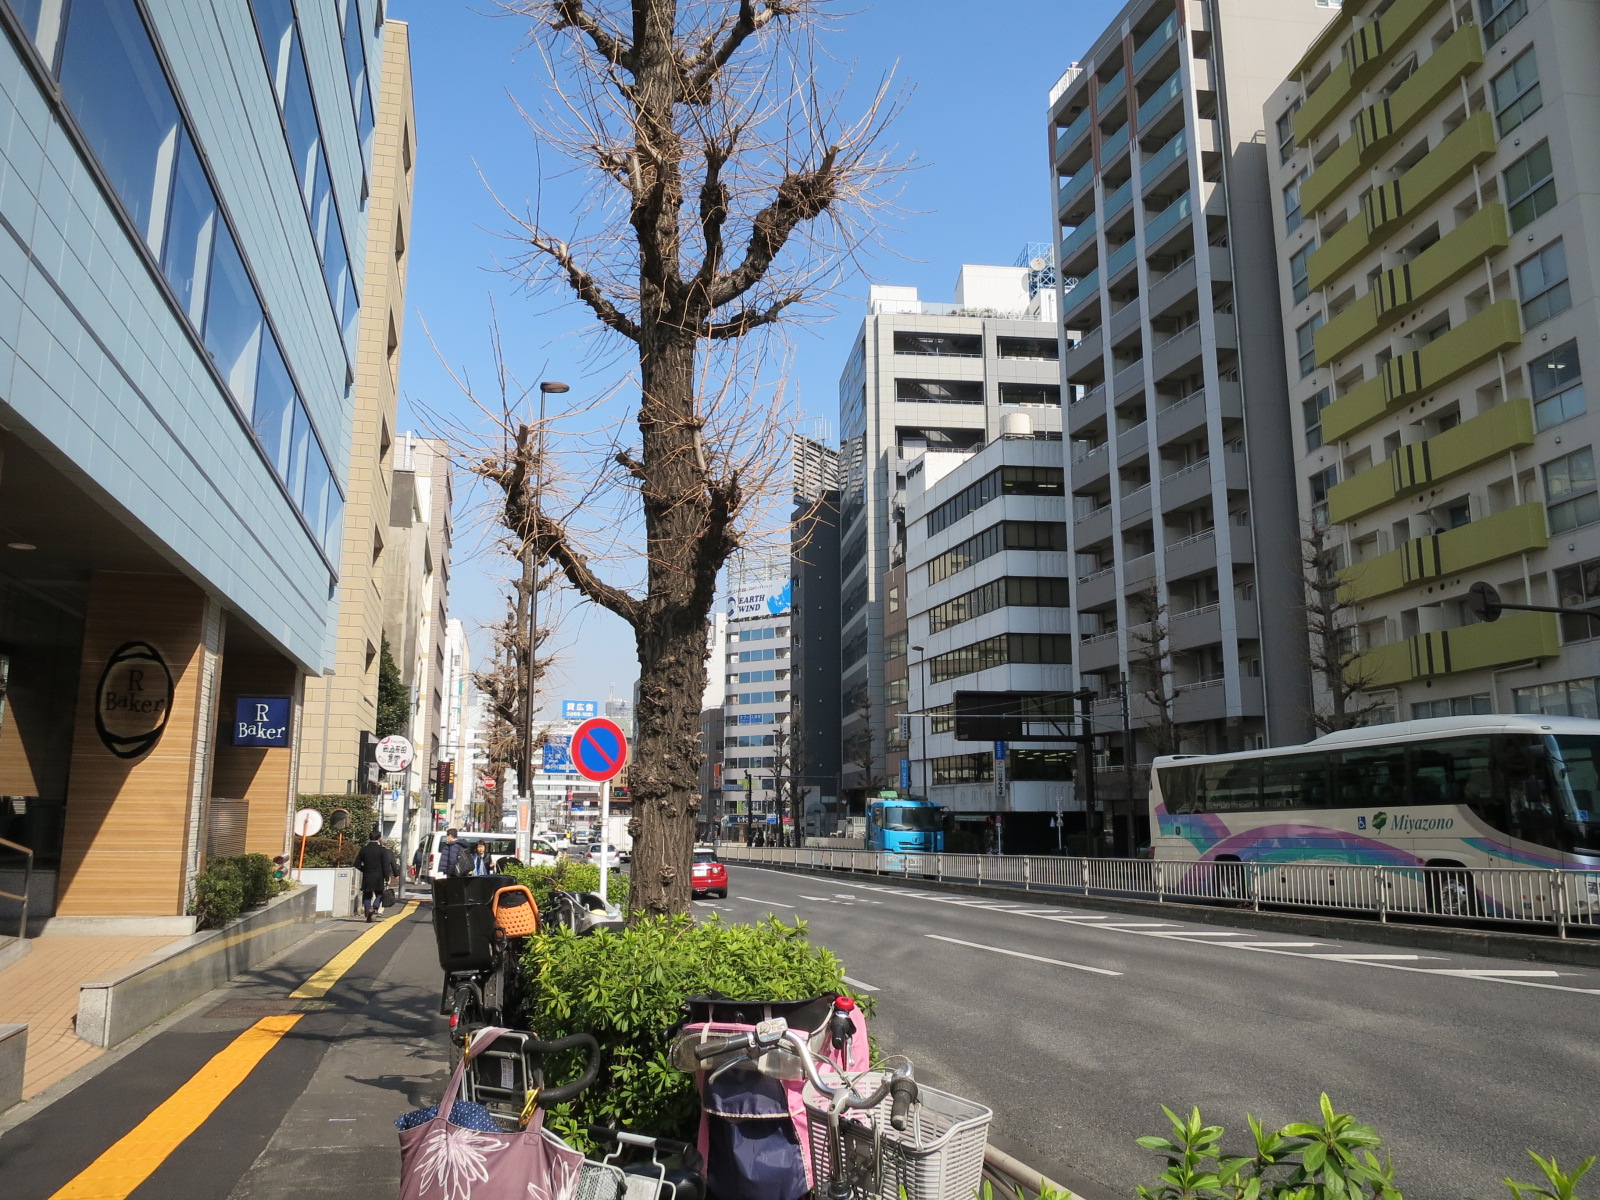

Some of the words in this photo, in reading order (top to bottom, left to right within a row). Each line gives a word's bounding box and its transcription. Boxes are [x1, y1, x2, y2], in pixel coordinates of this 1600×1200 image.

[738, 595, 765, 604] EARTH
[739, 604, 760, 612] WIND
[127, 669, 144, 691] R
[105, 692, 165, 714] Baker
[566, 702, 594, 712] 貸広告
[255, 703, 270, 722] R
[238, 722, 286, 740] Baker
[1390, 814, 1454, 834] Miyazono
